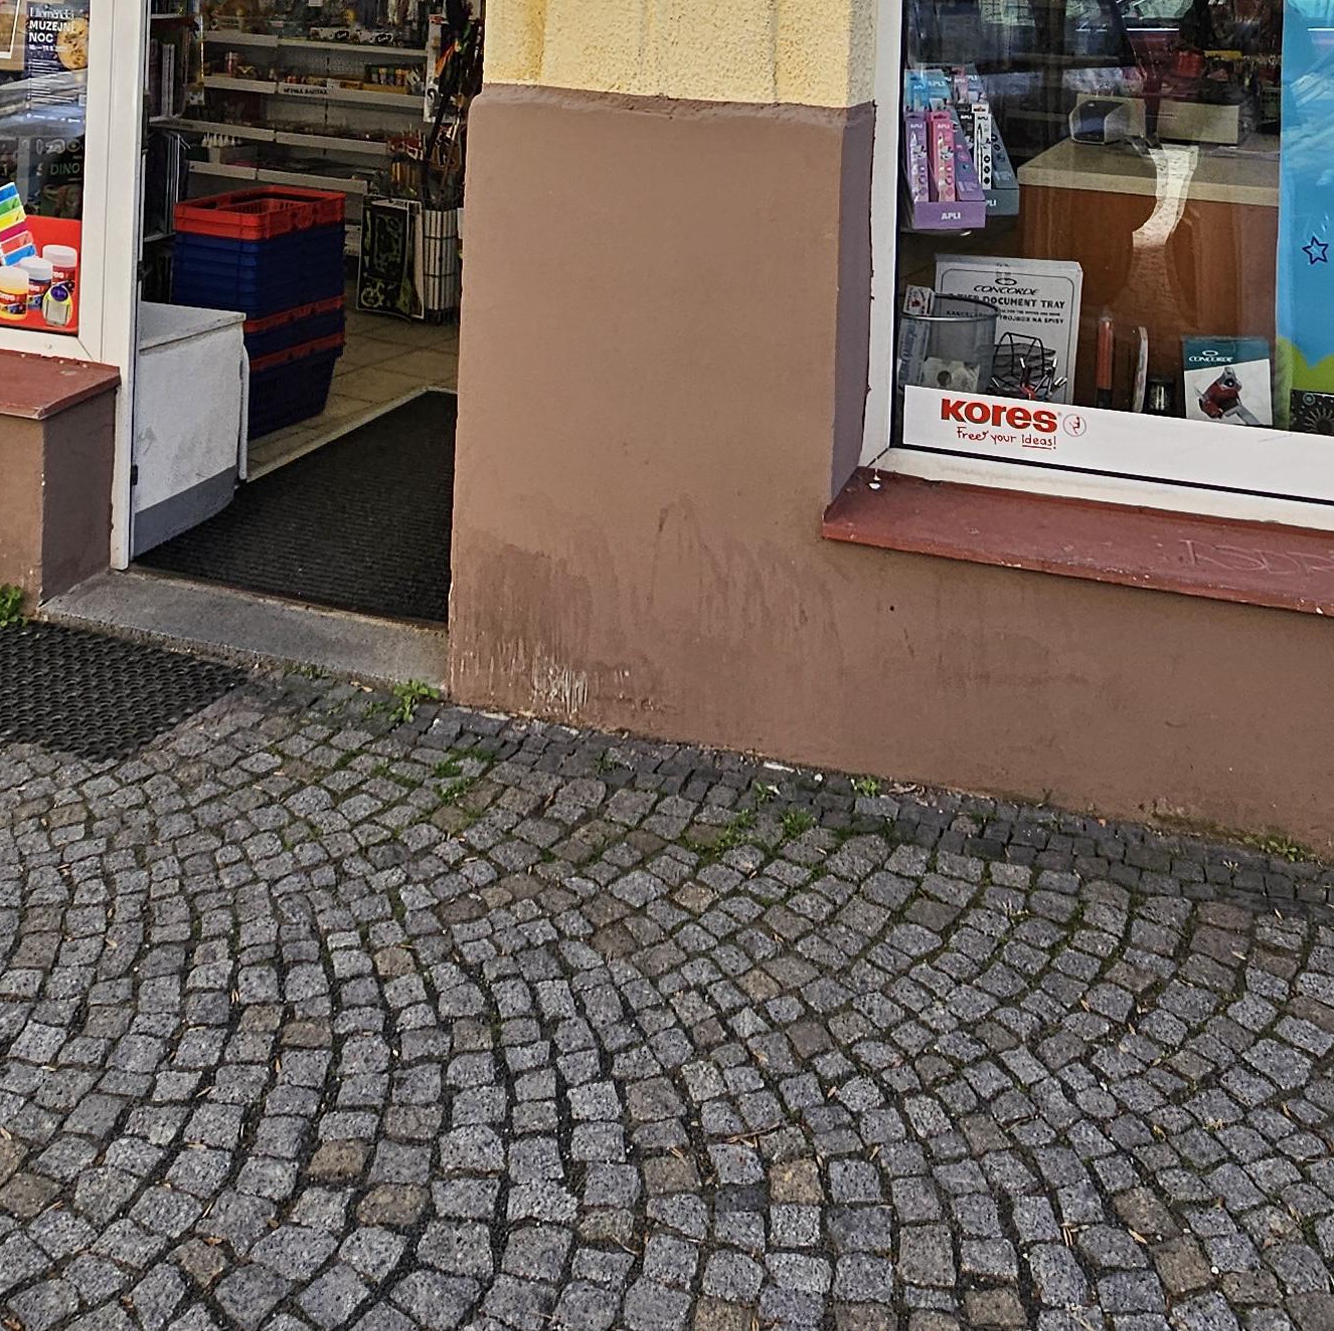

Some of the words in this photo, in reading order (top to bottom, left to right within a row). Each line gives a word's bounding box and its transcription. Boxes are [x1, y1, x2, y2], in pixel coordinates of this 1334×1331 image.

[28, 32, 54, 43] NOC
[940, 212, 962, 221] APLI
[973, 284, 1041, 296] CONCORDE
[982, 296, 1038, 308] DOCUMENT
[1040, 299, 1066, 310] TRAY
[990, 434, 1017, 446] your
